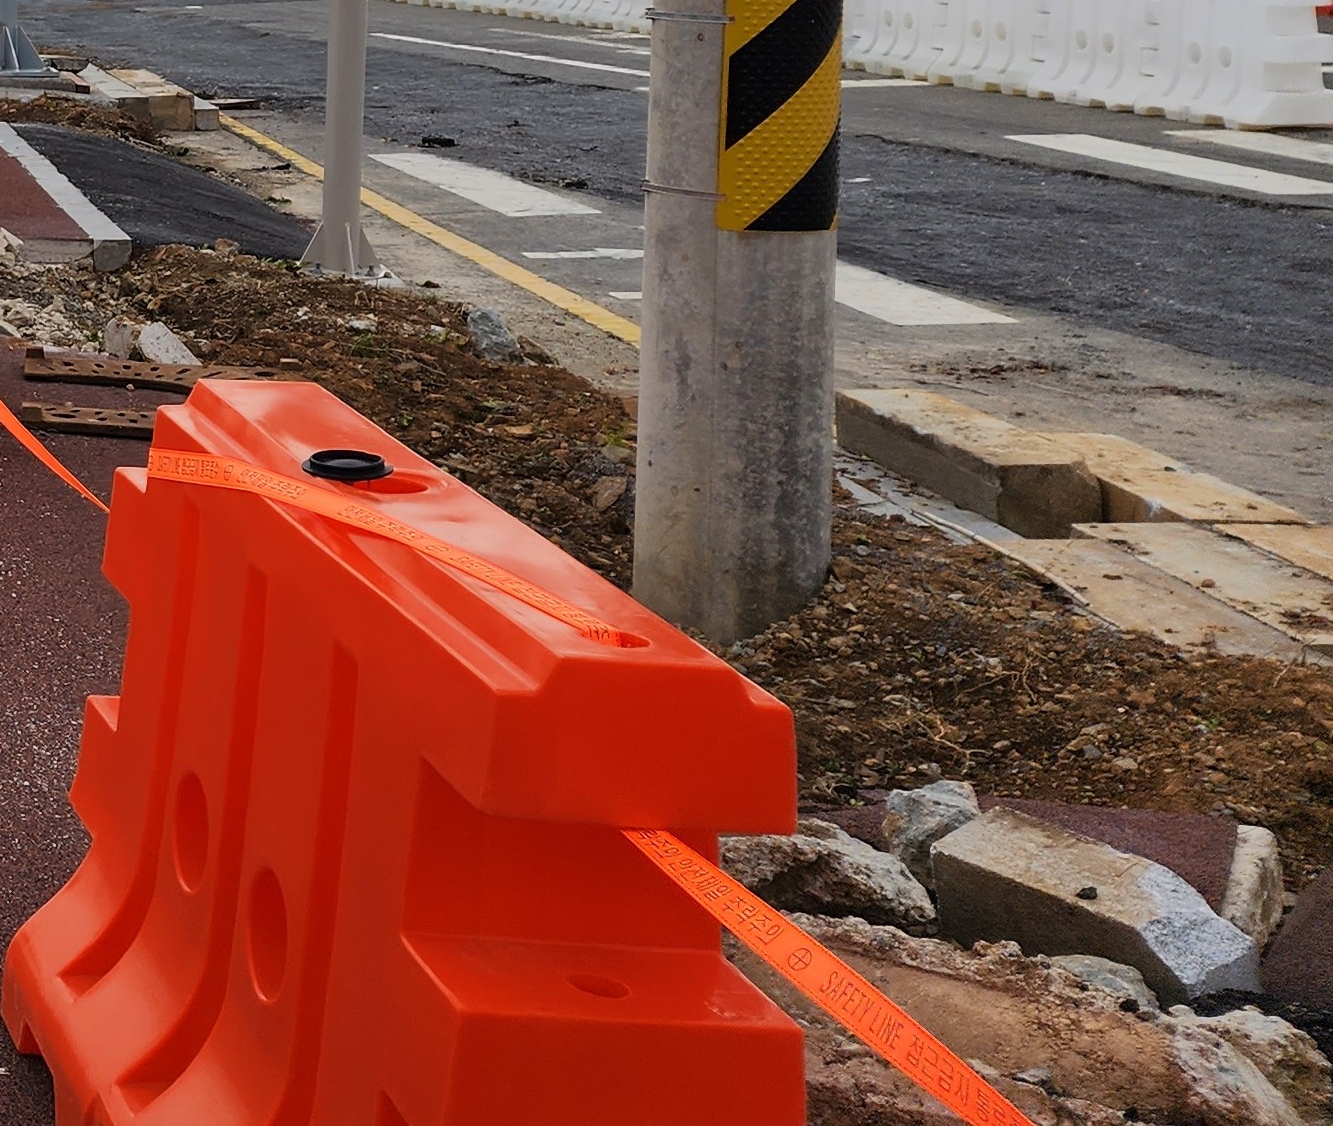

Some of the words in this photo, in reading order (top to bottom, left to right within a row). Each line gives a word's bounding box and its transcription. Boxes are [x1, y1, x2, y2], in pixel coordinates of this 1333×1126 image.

[668, 858, 732, 901] 안전제일
[722, 895, 786, 946] 추락주의
[820, 970, 873, 1022] SAFETY
[869, 1006, 904, 1050] LINE
[905, 1033, 970, 1105] 접근금지
[975, 1087, 1021, 1126] 통로
